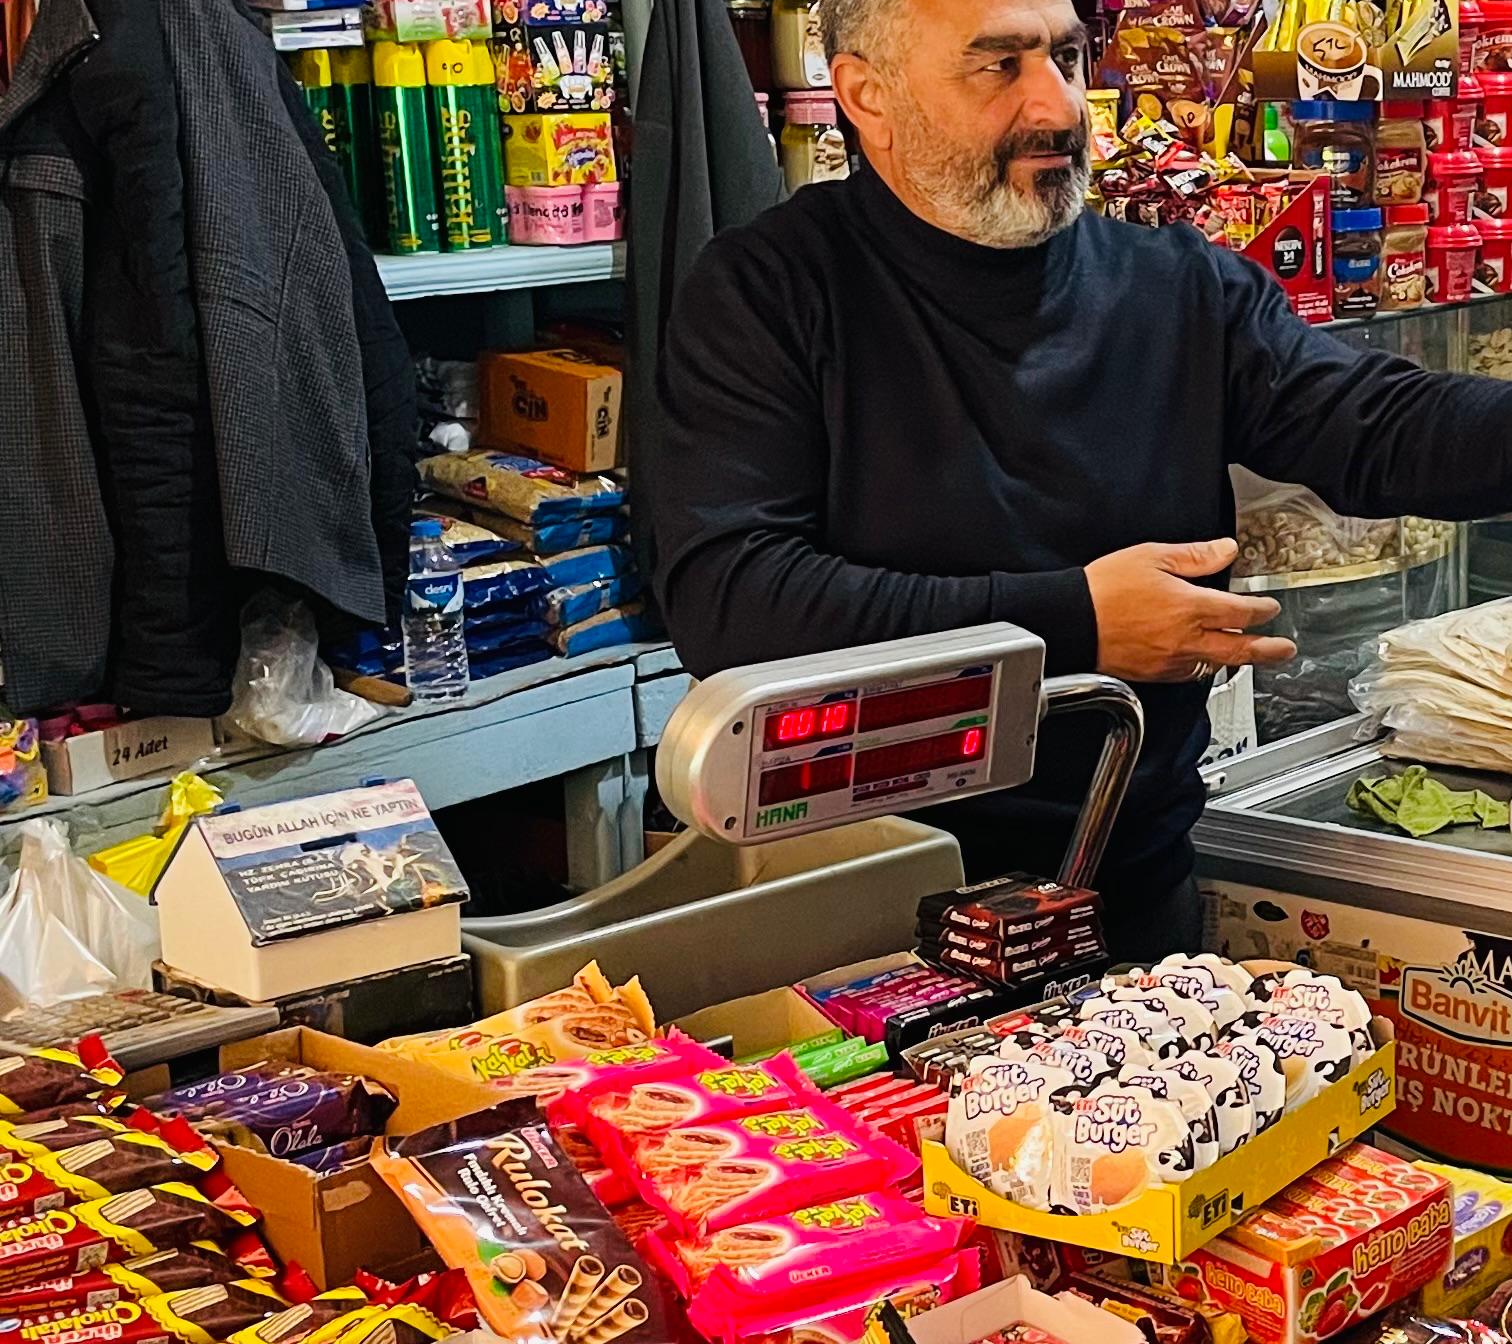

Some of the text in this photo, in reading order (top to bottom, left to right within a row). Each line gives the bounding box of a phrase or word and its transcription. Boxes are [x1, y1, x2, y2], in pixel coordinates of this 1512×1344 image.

[1392, 68, 1452, 90] MAHMOOD
[423, 582, 455, 597] desni
[134, 734, 169, 763] Adet
[963, 728, 980, 755] 0
[223, 825, 275, 846] BUGÜN
[276, 817, 320, 840] ALLAH
[351, 805, 373, 820] NE
[756, 802, 809, 829] HANA
[1290, 982, 1332, 1010] Süt
[1410, 982, 1512, 1035] Banvit
[980, 1062, 1027, 1091] Süt
[965, 1078, 1045, 1118] Burger
[1094, 1094, 1141, 1123] Süt
[1075, 1116, 1158, 1152] Burger
[487, 1133, 594, 1252] Rulokat
